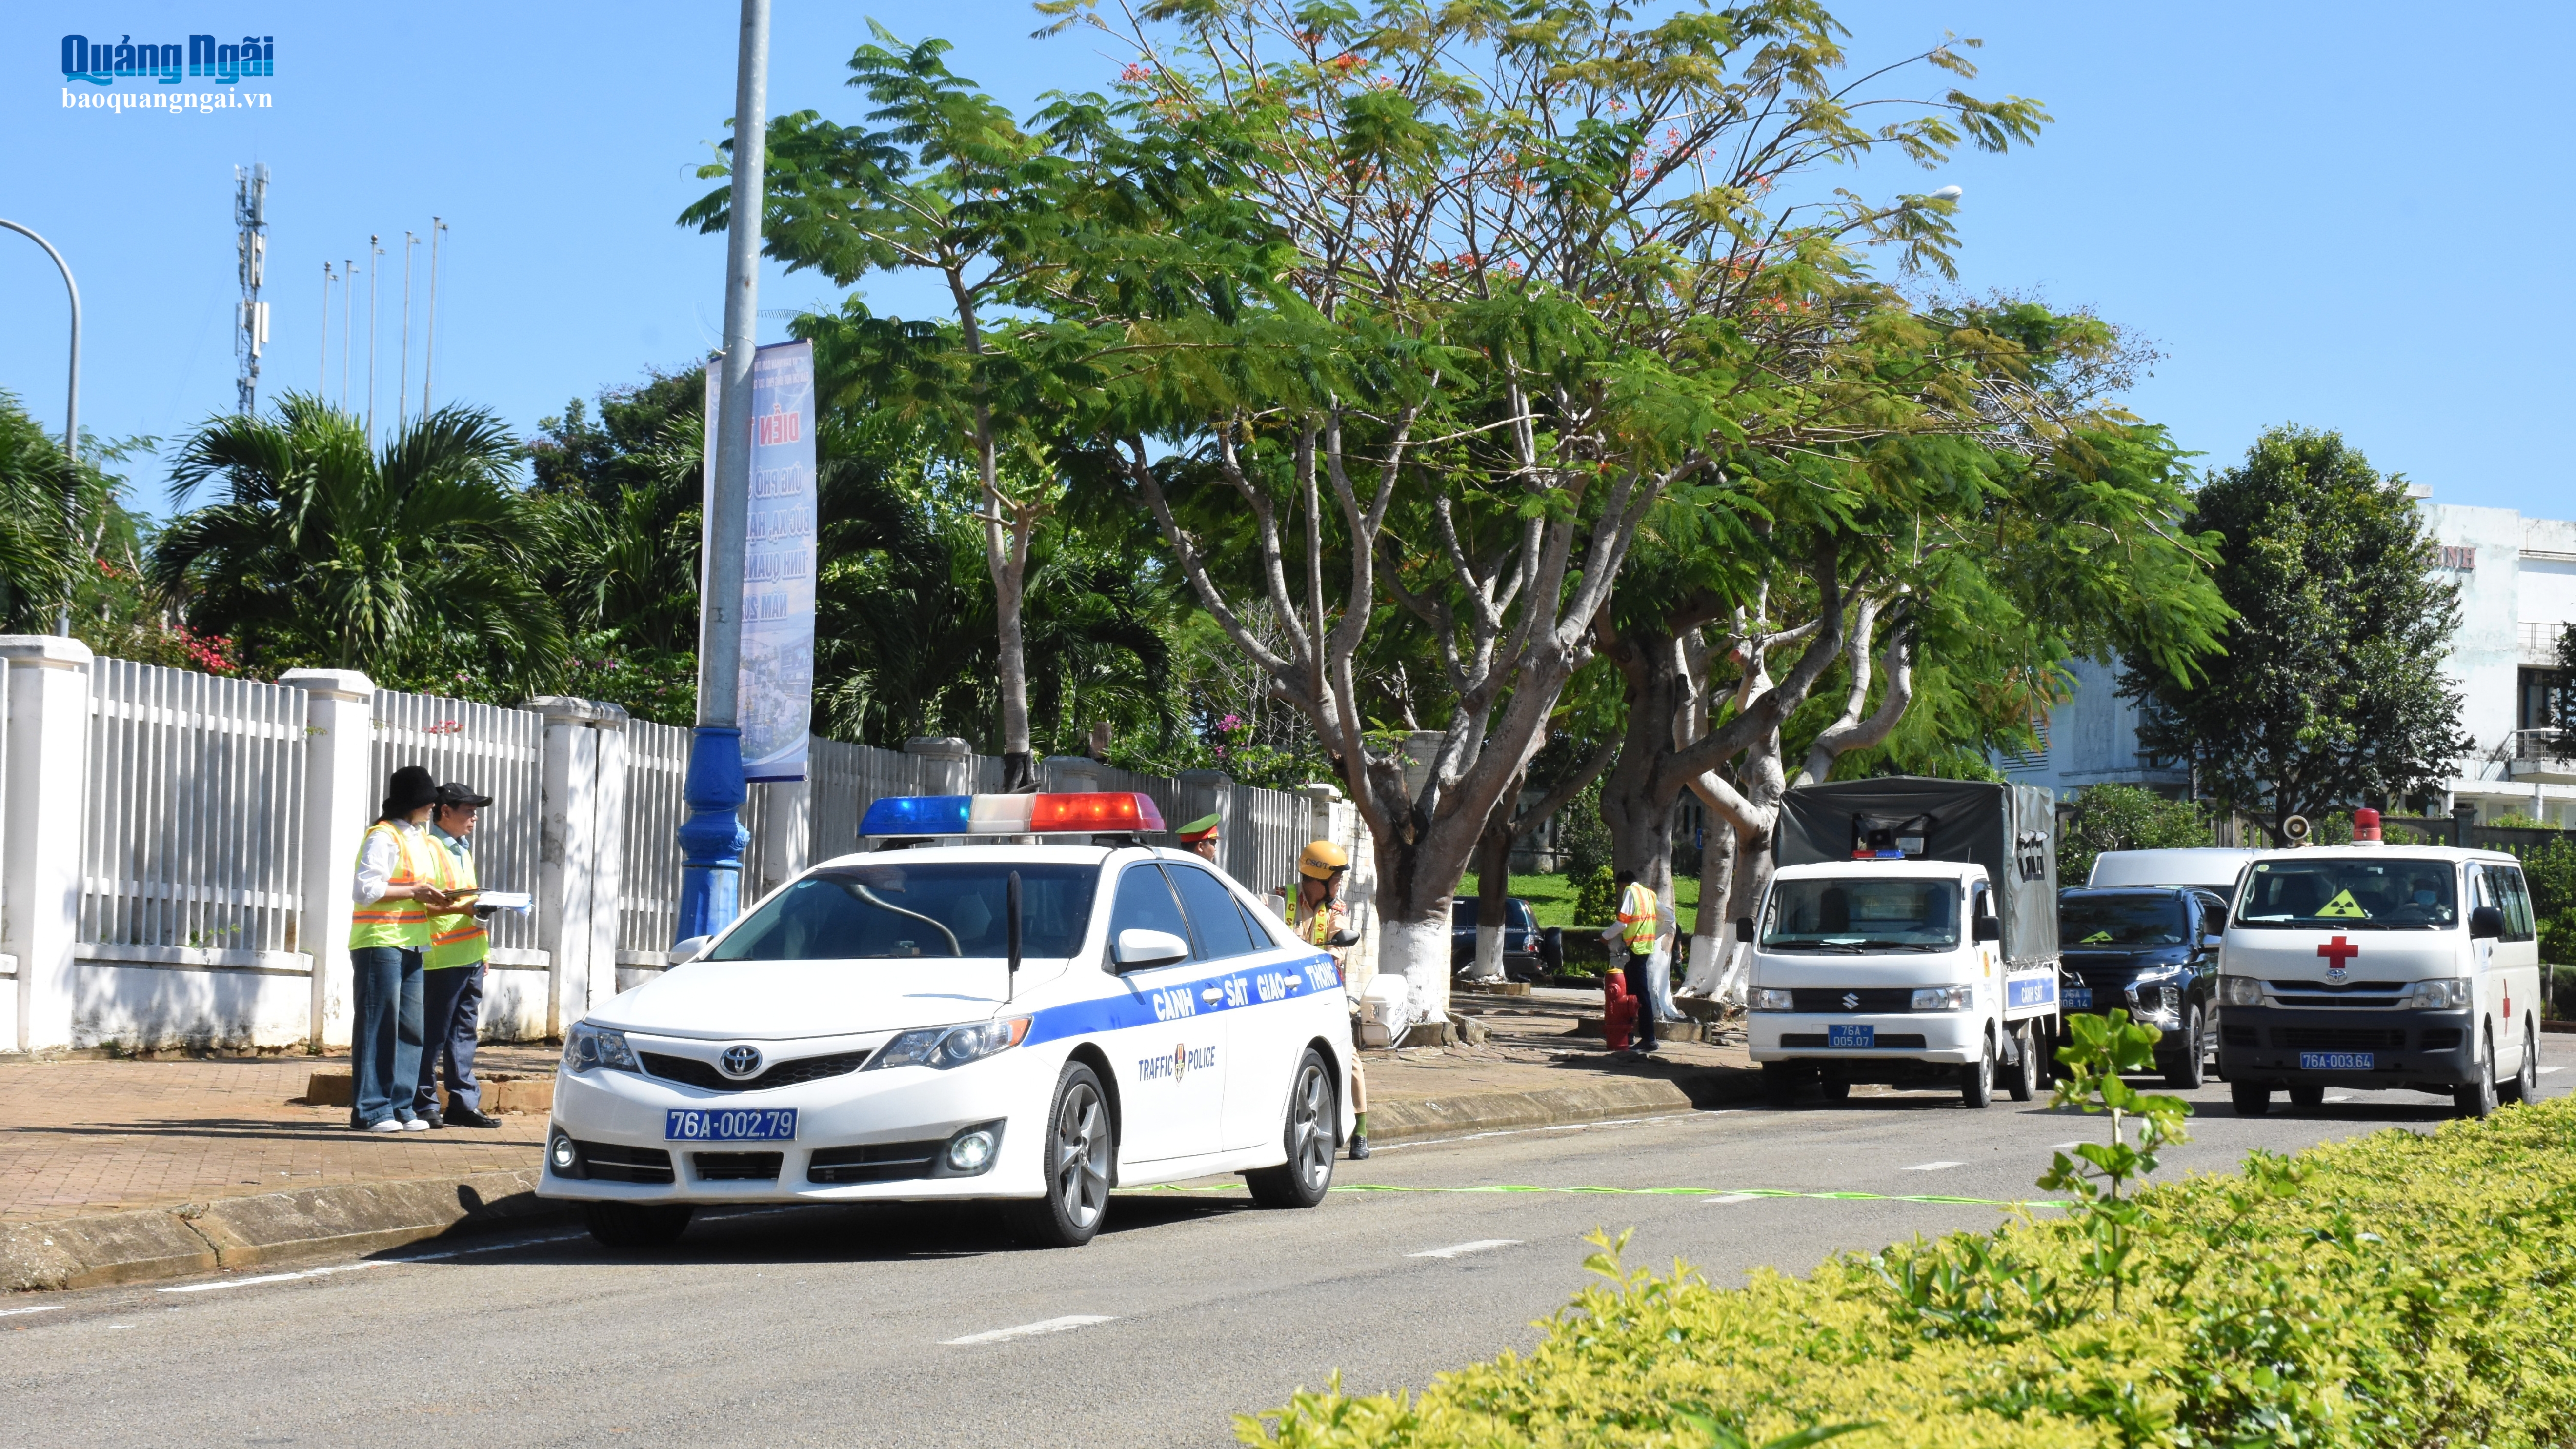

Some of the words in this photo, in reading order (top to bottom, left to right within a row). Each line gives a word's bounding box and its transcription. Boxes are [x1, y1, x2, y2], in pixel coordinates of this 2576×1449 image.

[1305, 858, 1328, 870] CSGT
[1152, 987, 1196, 1021] CẢNH
[1224, 974, 1249, 1007] SÁT
[1256, 975, 1285, 1002] GIAO
[1305, 959, 1338, 992] THÔNG
[2021, 982, 2034, 1003] CẢNH
[2034, 981, 2043, 1001] SÁT
[2064, 990, 2080, 998] 76A
[1841, 1026, 1860, 1035] 76A
[1833, 1036, 1869, 1046] 005.07
[1138, 1054, 1173, 1081] TRAFFIC
[1188, 1046, 1215, 1072] POLICE
[2303, 1054, 2371, 1068] 76A-003.64
[671, 1111, 793, 1137] 76A-002.79
